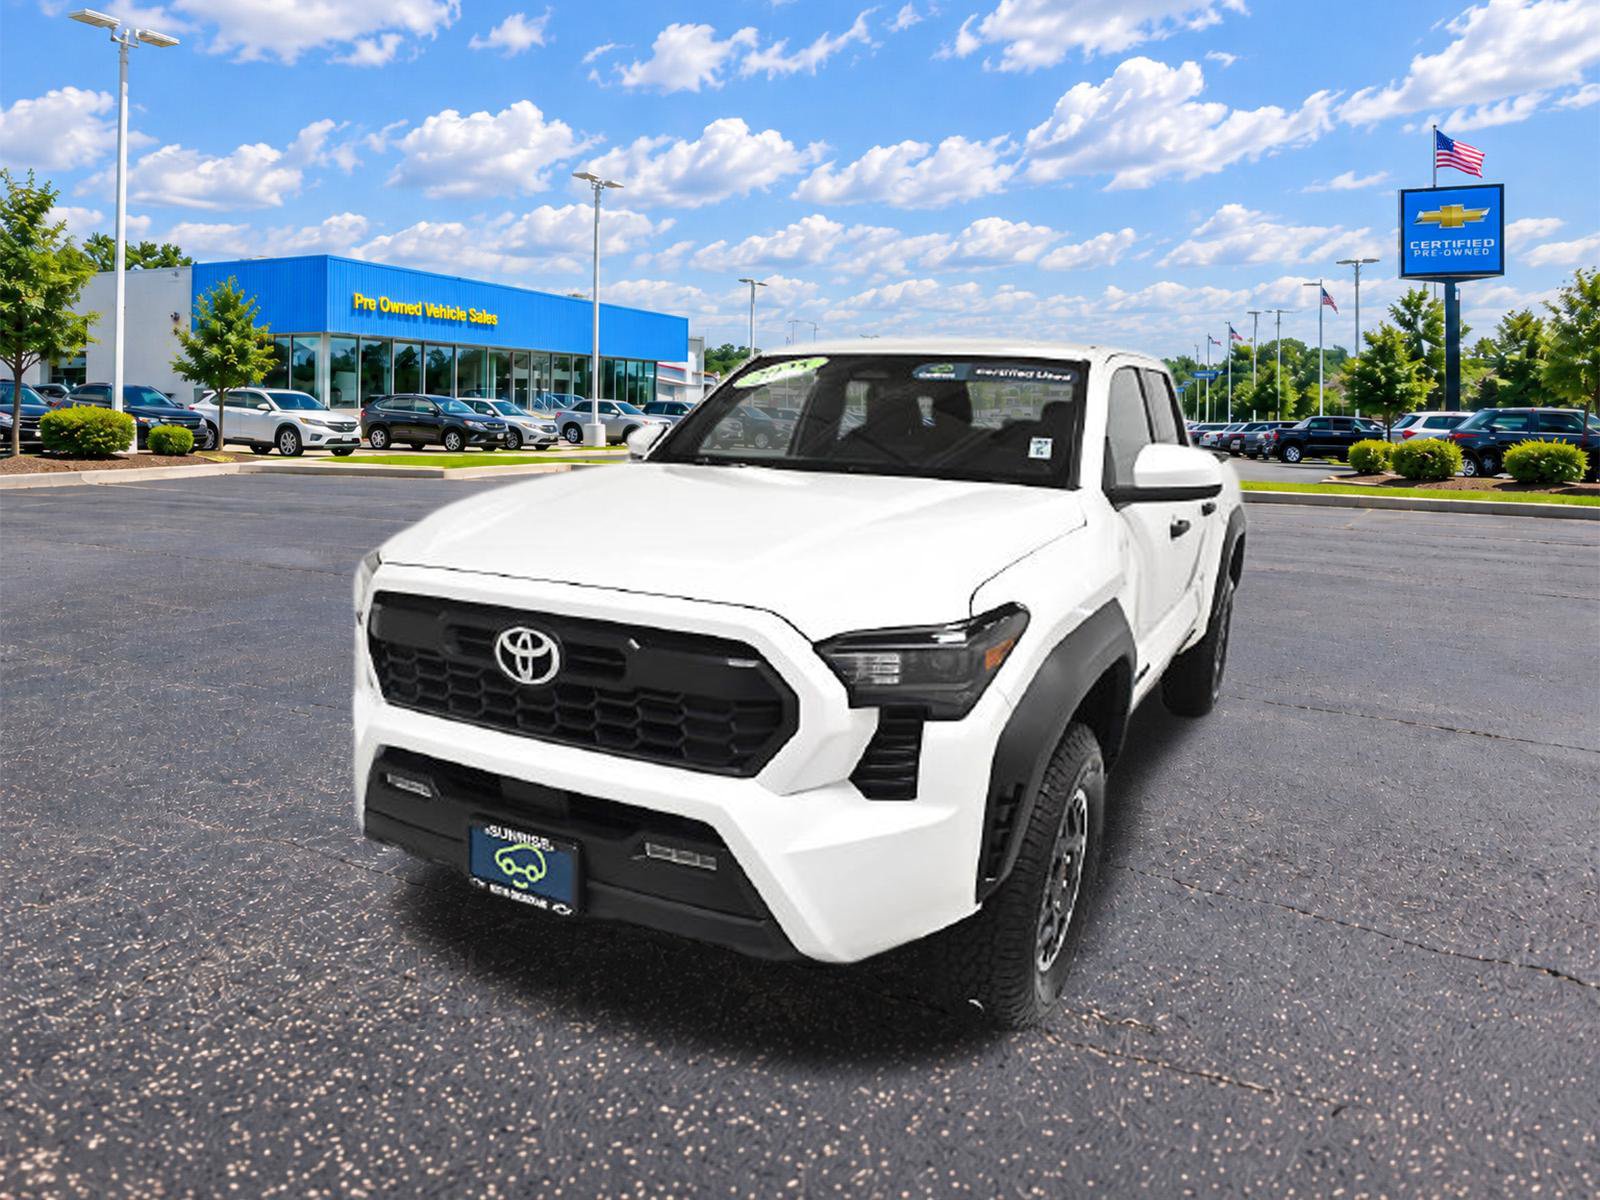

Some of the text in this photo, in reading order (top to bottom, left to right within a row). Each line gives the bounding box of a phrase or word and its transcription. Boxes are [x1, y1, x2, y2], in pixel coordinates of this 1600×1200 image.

[1410, 239, 1495, 249] CERTIFIED
[1414, 248, 1489, 257] PRE-OWNED
[353, 293, 498, 325] Pre Owned Vehicle Sales
